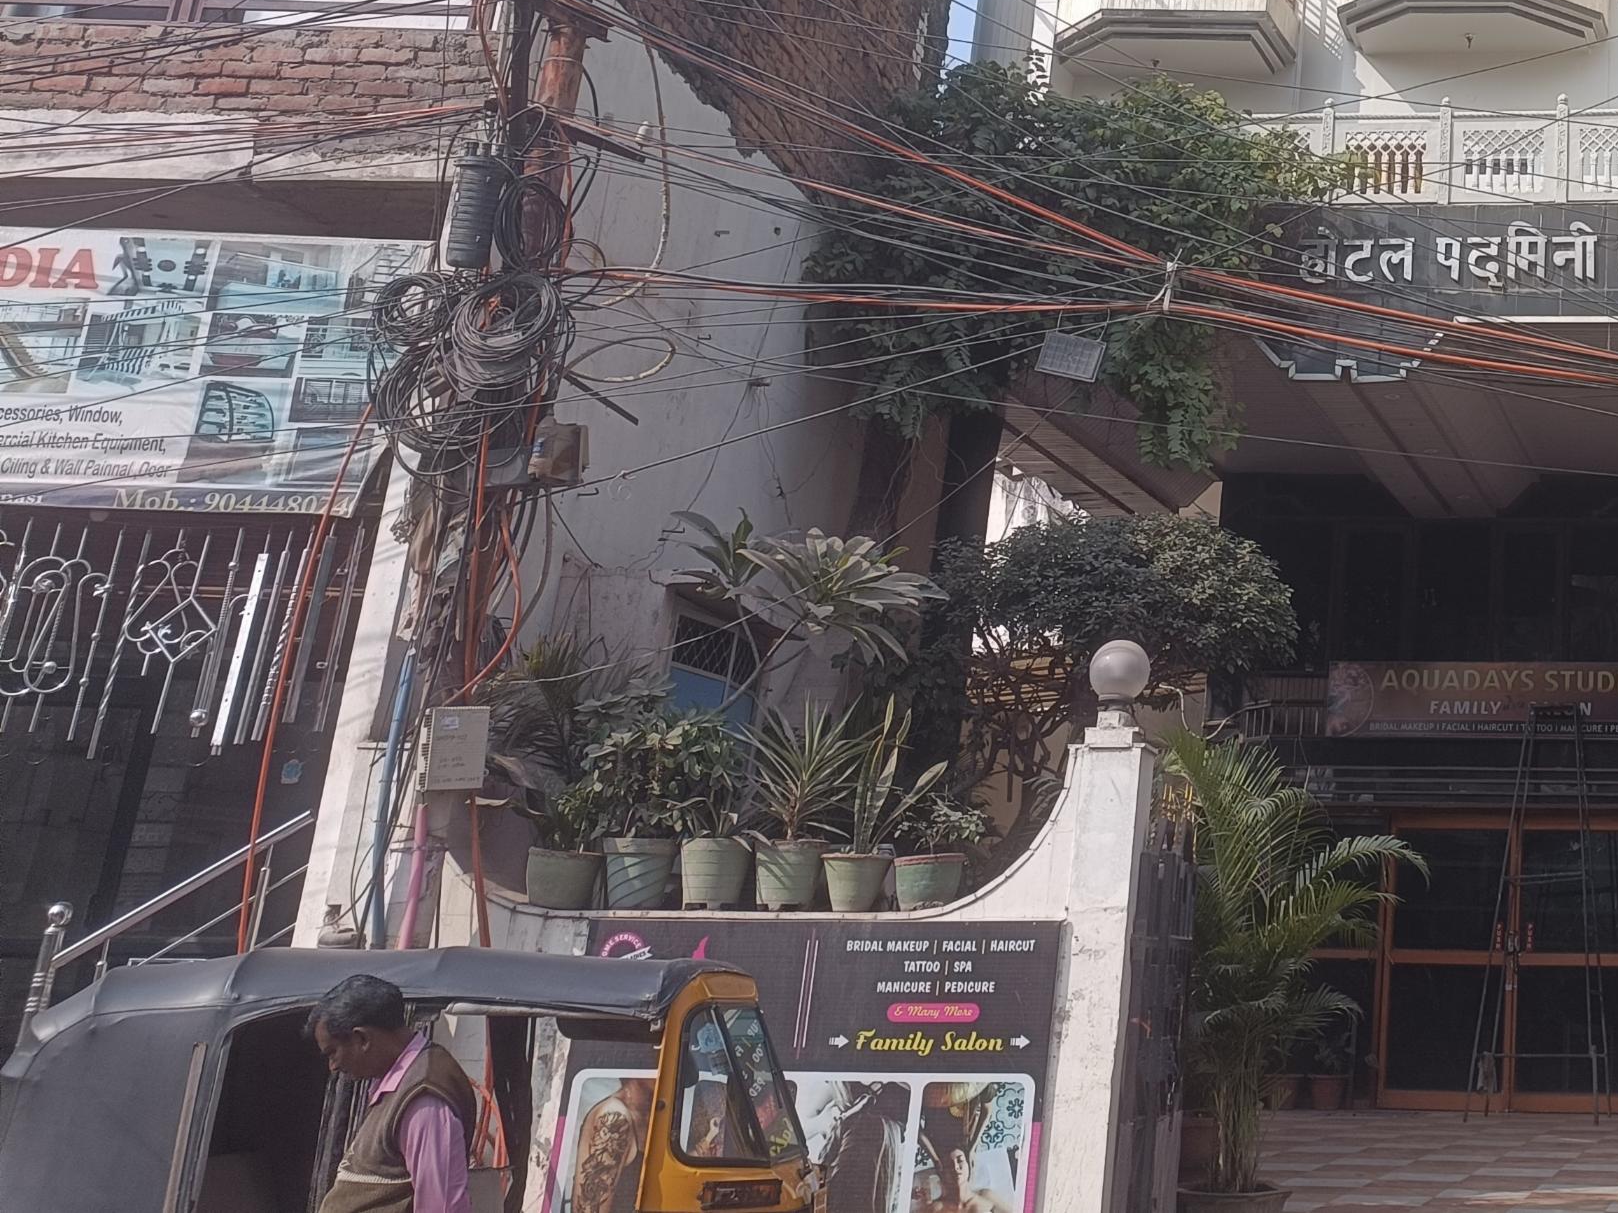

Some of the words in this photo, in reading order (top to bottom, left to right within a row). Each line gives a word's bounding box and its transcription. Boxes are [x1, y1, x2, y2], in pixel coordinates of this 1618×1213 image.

[1299, 226, 1415, 284] होटल
[68, 405, 123, 426] Window,
[37, 431, 90, 450] Kitchen
[92, 432, 166, 454] Equipment,
[1, 457, 38, 479] Ciling
[40, 458, 51, 475] &
[54, 458, 82, 476] Wall
[1381, 668, 1535, 695] AQUADAYS
[1429, 700, 1502, 715] FAMILY
[1369, 721, 1399, 732] BRIDAL
[1400, 721, 1435, 732] MAKEUP
[1441, 722, 1471, 732] FACIAL
[1479, 722, 1513, 733] HAIRCUT
[614, 933, 643, 949] SERVICE
[846, 939, 884, 953] BRIDAL
[886, 939, 930, 953] MAKEUP
[942, 939, 977, 953] FACIAL
[990, 939, 1036, 953] HAIRCUT
[903, 960, 941, 974] TATTOO
[953, 960, 972, 974] SPA
[876, 981, 932, 994] MANICURE
[944, 981, 996, 994] PEDICURE
[894, 1006, 903, 1017] &
[906, 1005, 941, 1019] Many
[943, 1005, 974, 1017] More
[855, 1028, 935, 1057] Family
[940, 1030, 1004, 1052] Salon
